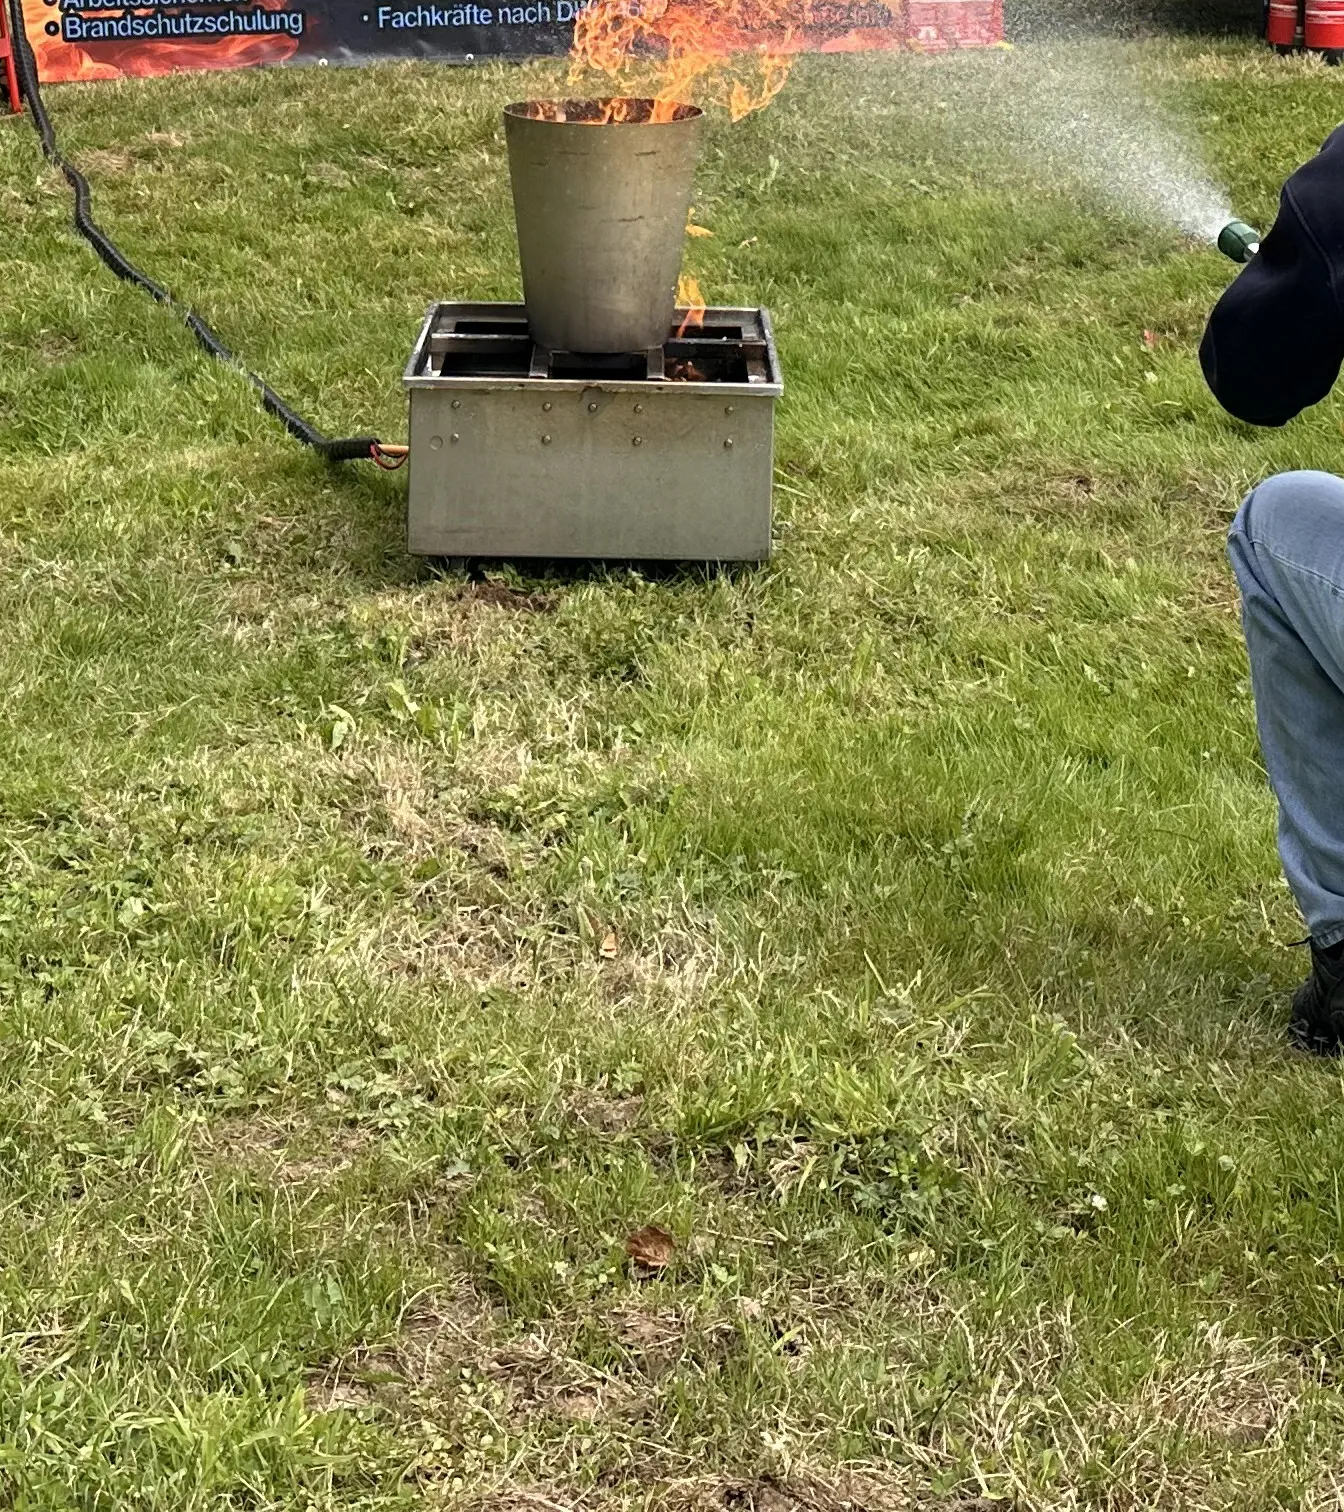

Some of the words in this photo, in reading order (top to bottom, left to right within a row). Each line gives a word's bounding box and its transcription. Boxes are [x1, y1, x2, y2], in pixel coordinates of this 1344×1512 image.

[66, 10, 303, 39] Brandschutzschulung
[378, 3, 493, 28] Fachkräfte
[498, 2, 550, 24] nach
